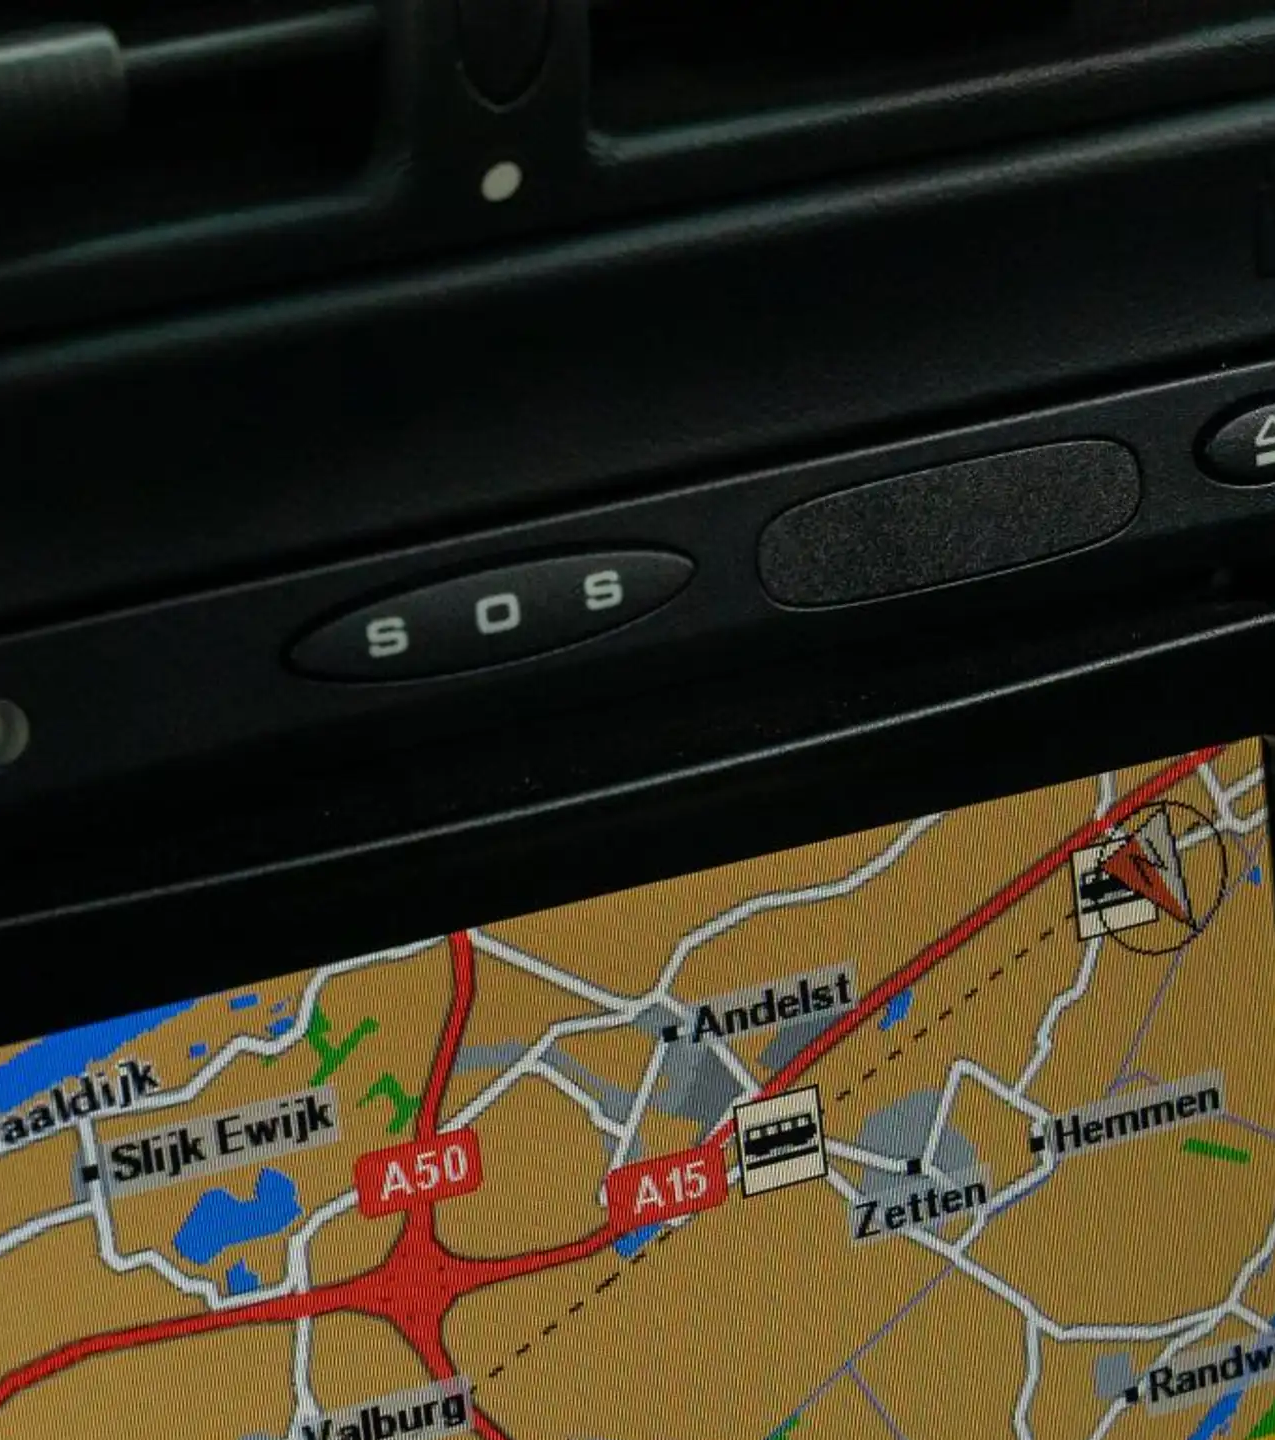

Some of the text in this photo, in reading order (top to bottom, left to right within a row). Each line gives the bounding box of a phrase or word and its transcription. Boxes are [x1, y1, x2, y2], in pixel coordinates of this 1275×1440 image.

[690, 970, 853, 1041] Andelst
[110, 1096, 334, 1185] Slijk Ewijk
[1052, 1085, 1222, 1154] Hemmen
[380, 1152, 470, 1201] A50
[632, 1161, 709, 1213] A15
[855, 1180, 989, 1240] Zetten
